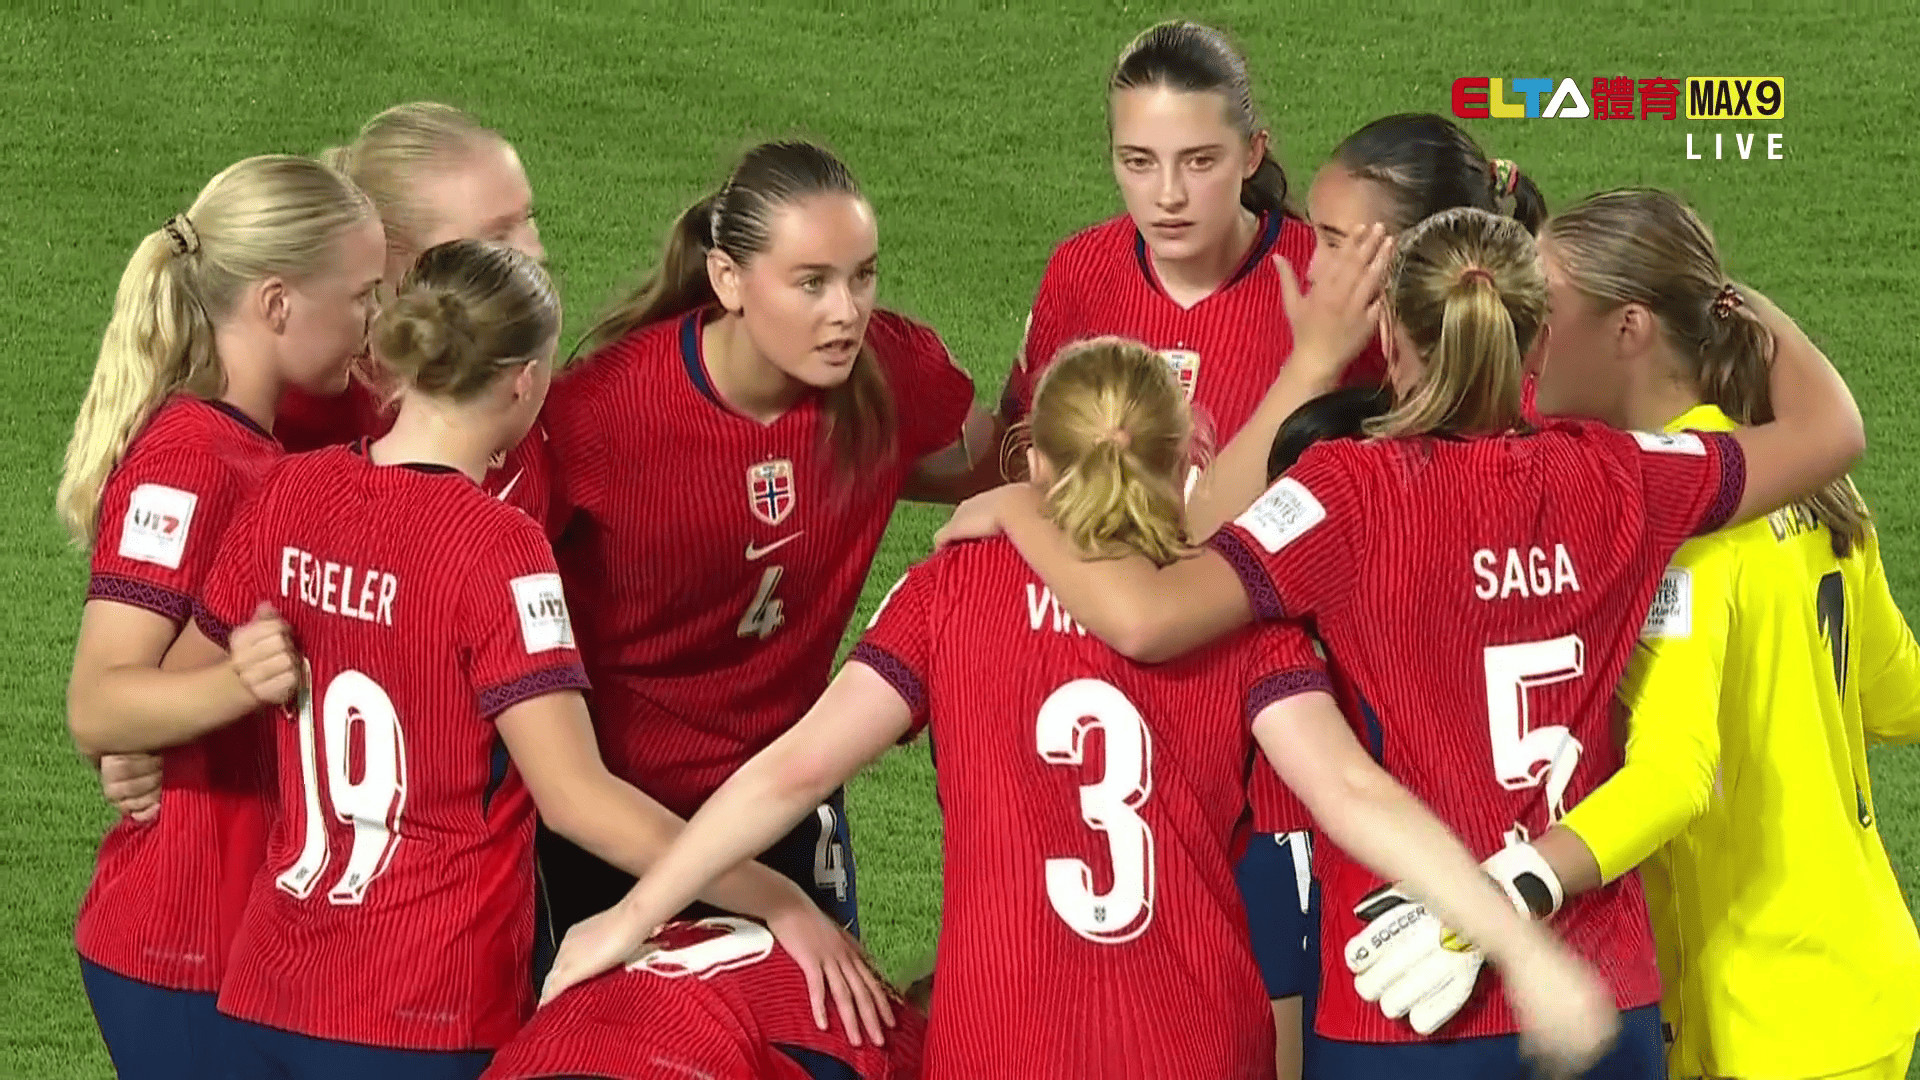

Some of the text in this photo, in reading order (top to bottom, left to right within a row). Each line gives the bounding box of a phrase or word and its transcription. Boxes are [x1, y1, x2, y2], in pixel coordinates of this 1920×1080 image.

[280, 545, 398, 626] FEDELER
[737, 565, 786, 641] 4
[1473, 543, 1580, 600] SAGA
[1484, 633, 1584, 846] 5
[275, 655, 408, 906] 19
[1035, 678, 1155, 944] 3
[1370, 905, 1427, 949] SOCCER
